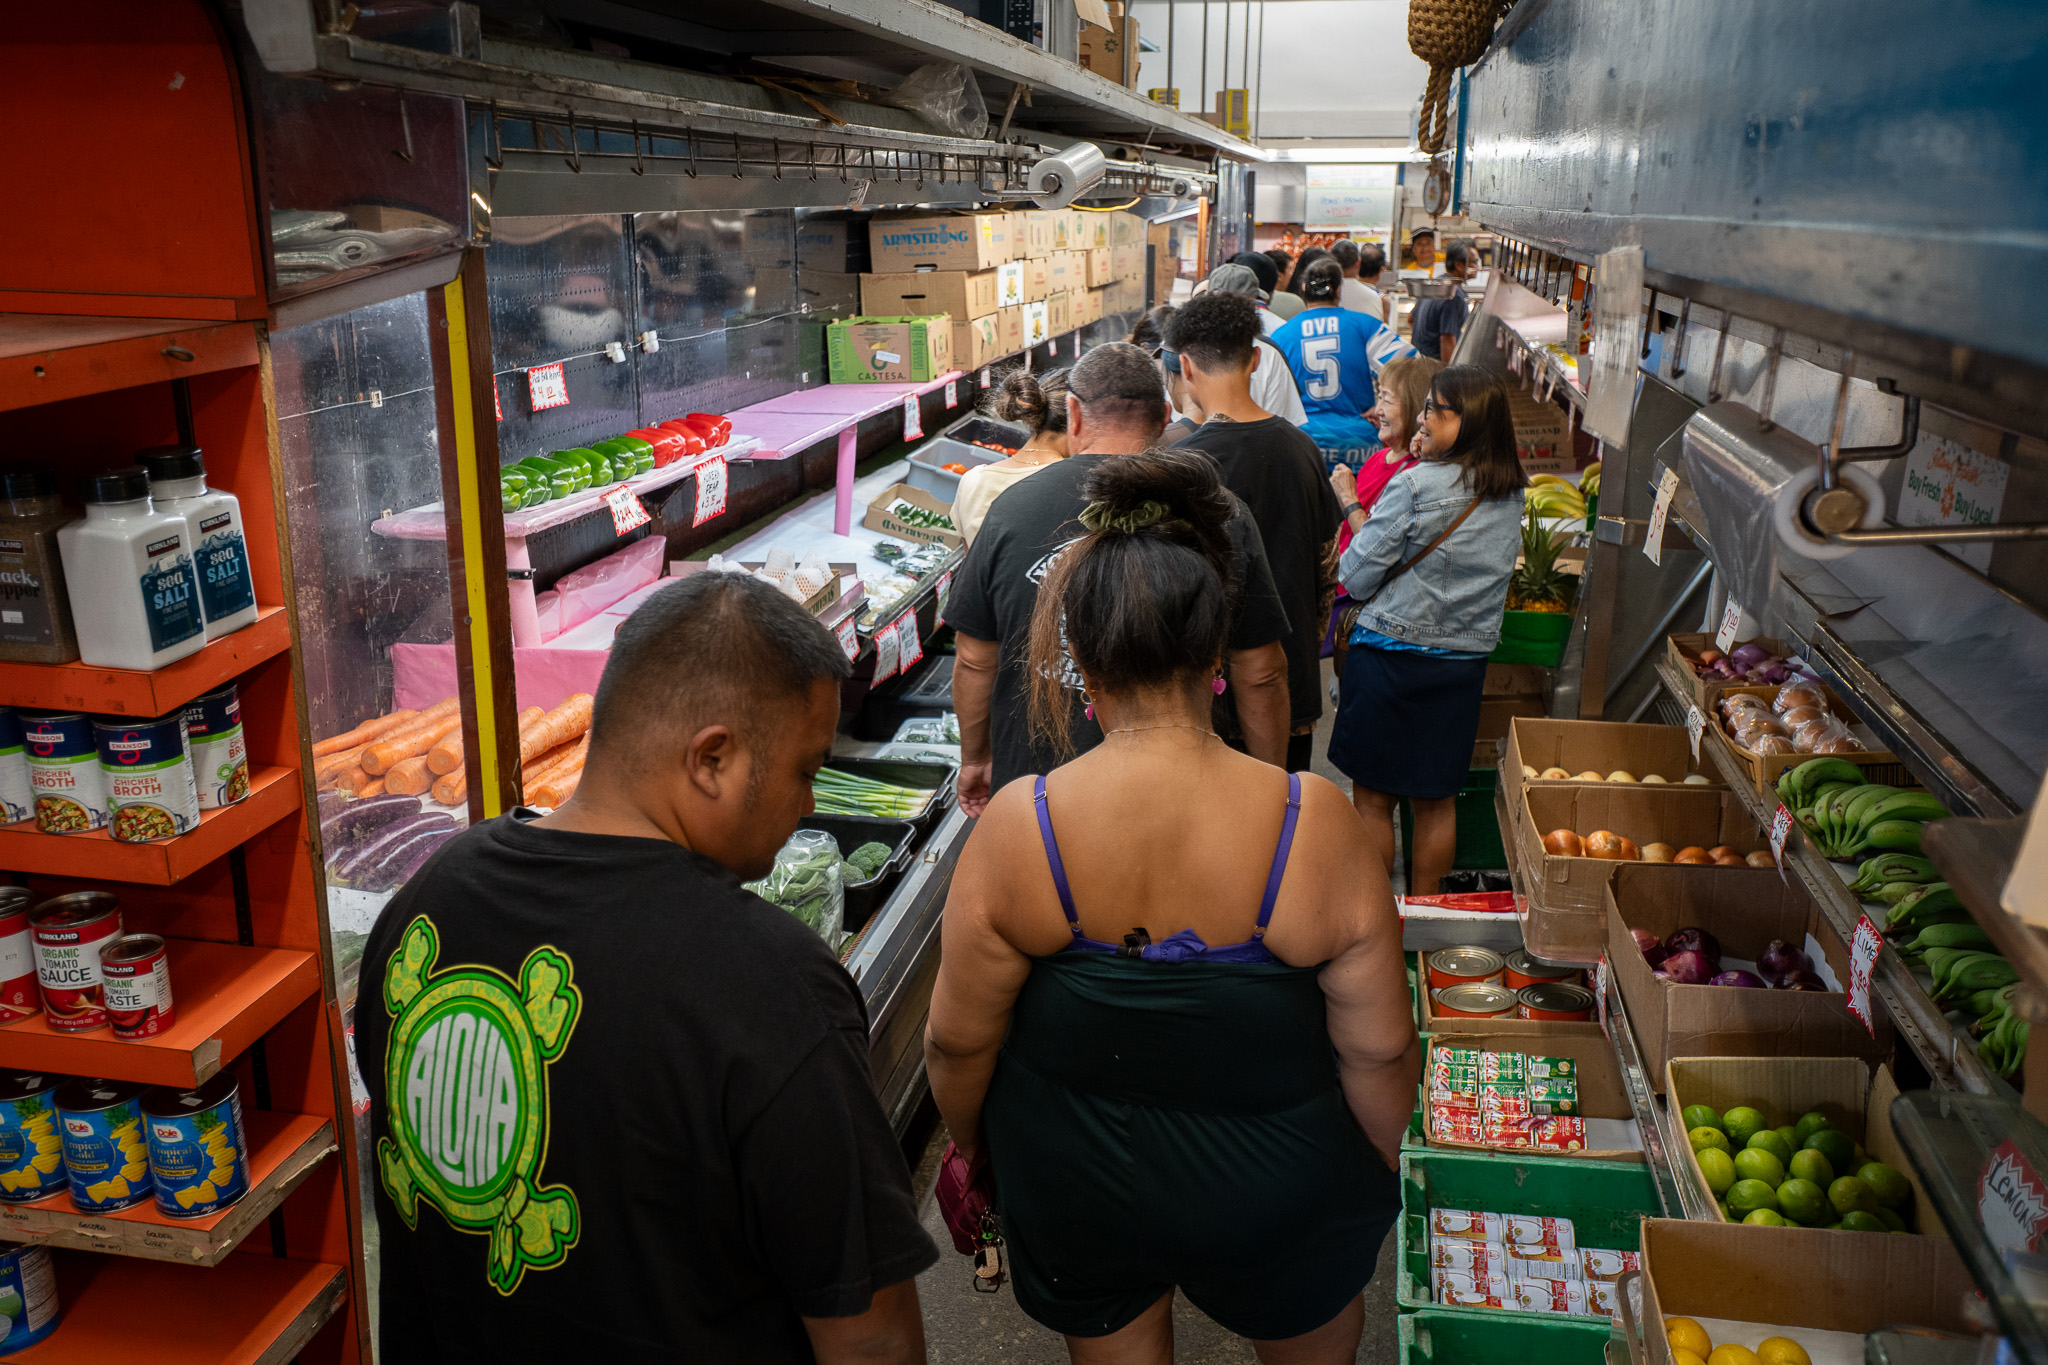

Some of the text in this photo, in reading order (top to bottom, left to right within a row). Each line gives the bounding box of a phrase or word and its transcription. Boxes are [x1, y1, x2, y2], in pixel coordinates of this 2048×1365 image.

[882, 226, 968, 246] ARMSTRONG
[1301, 316, 1340, 337] OVA
[1301, 334, 1342, 402] 5
[1909, 469, 1922, 497] Buy
[1921, 475, 1942, 502] Fresh
[1954, 492, 1971, 522] Buy
[210, 546, 235, 566] sea
[206, 558, 240, 584] SALT
[0, 568, 39, 588] ack
[157, 571, 184, 591] sea
[153, 582, 190, 610] SALT
[28, 733, 63, 742] SWANSON
[111, 741, 149, 750] SWANSON
[229, 745, 244, 759] BRO
[31, 769, 71, 778] CHICKEN
[32, 776, 76, 788] BROTH
[114, 777, 158, 786] CHICKEN
[113, 784, 162, 797] BROTH
[38, 932, 79, 941] KIRKLAND
[1858, 931, 1877, 961] LIME
[42, 948, 80, 959] ORGANIC
[45, 959, 78, 969] TOMATO
[40, 967, 92, 983] SAUCE
[108, 988, 130, 996] TOMATO
[105, 993, 141, 1006] PASTE
[407, 1012, 518, 1187] ALOHA
[69, 1123, 89, 1131] Dole
[157, 1129, 177, 1137] Dole
